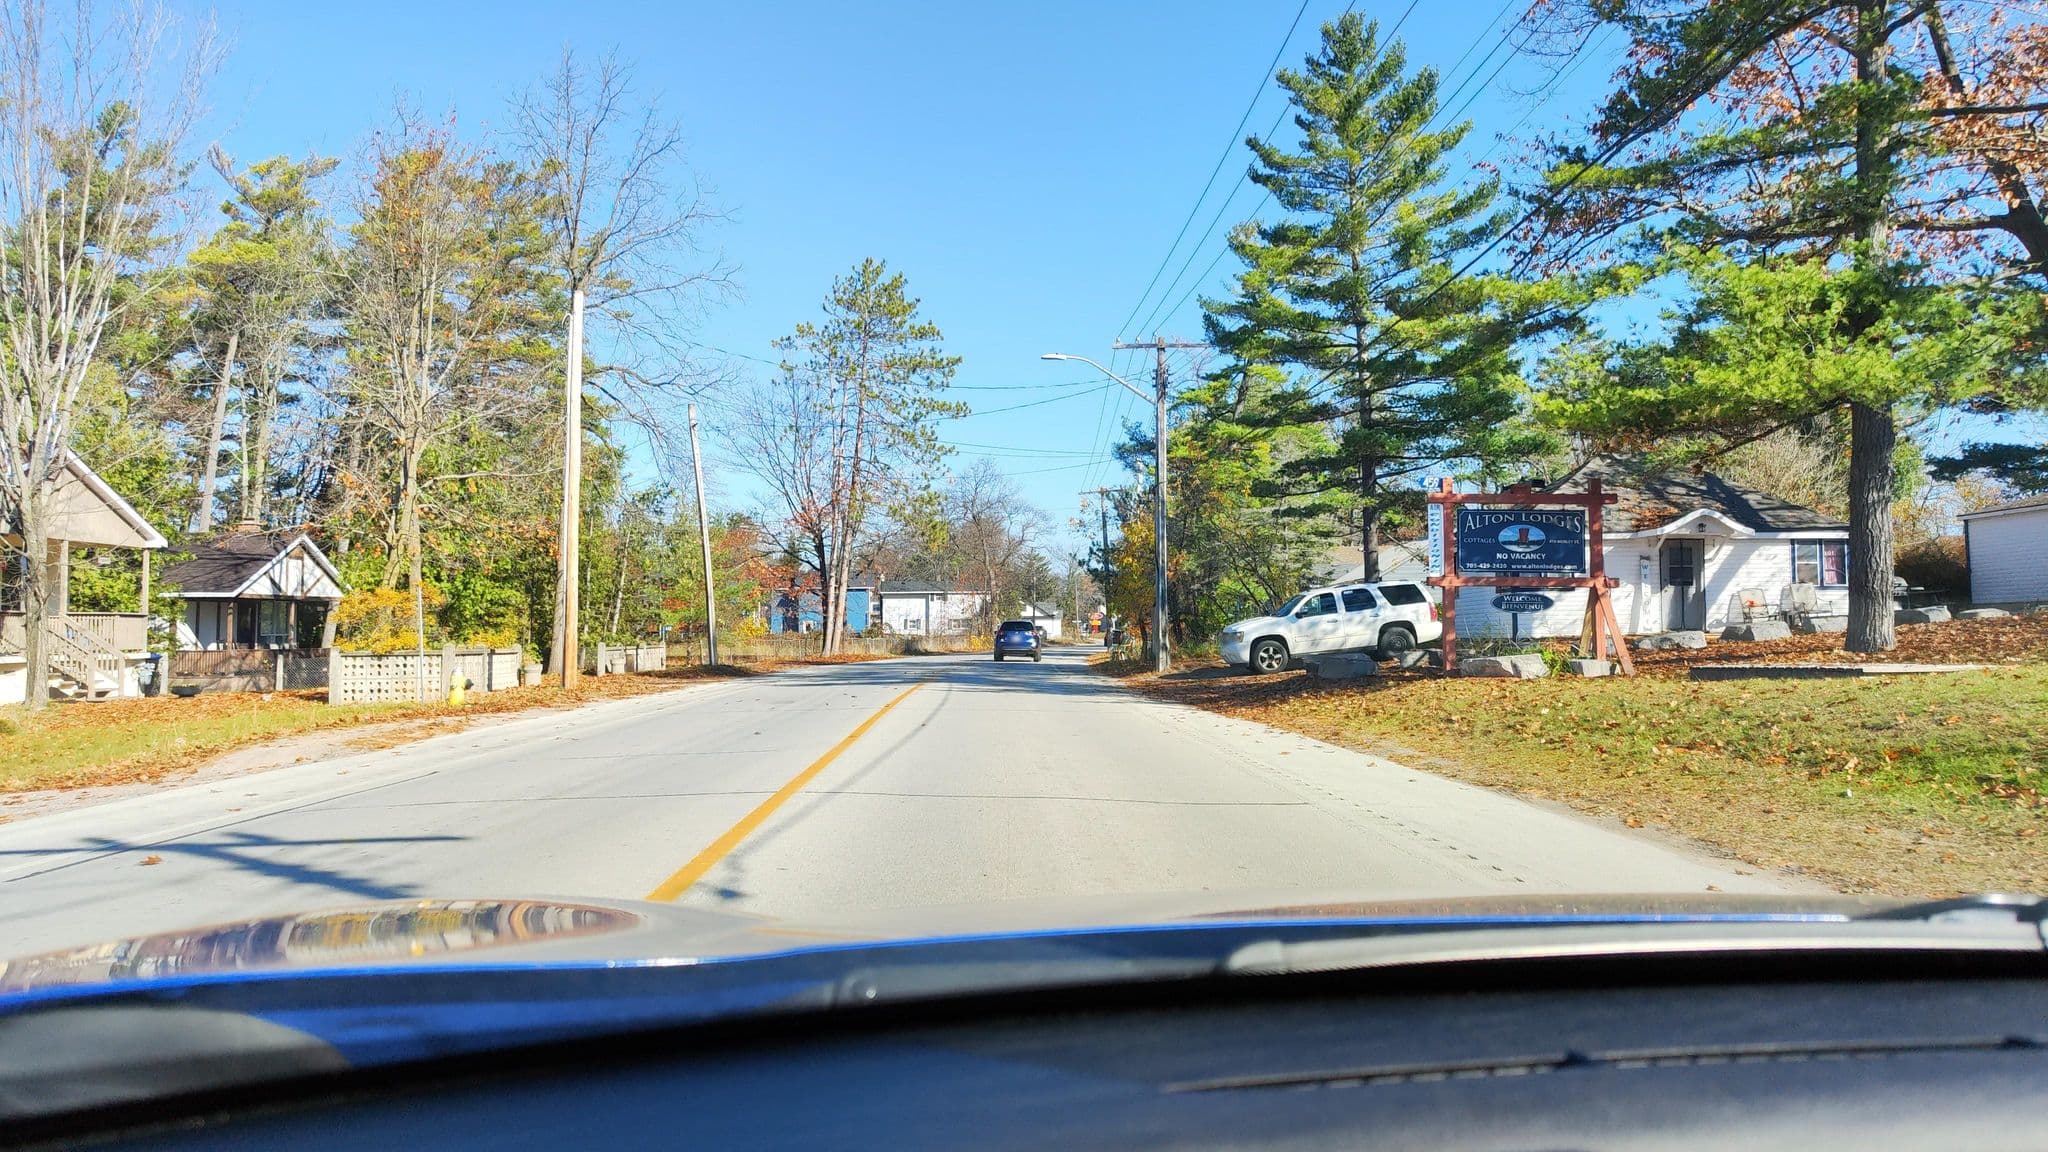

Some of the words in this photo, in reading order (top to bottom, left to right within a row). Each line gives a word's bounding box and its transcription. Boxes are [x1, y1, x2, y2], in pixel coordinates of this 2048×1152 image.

[1423, 477, 1440, 488] 459
[1464, 513, 1515, 533] ALTON
[1522, 513, 1581, 533] LODGES
[1501, 602, 1544, 610] BIENVENUE
